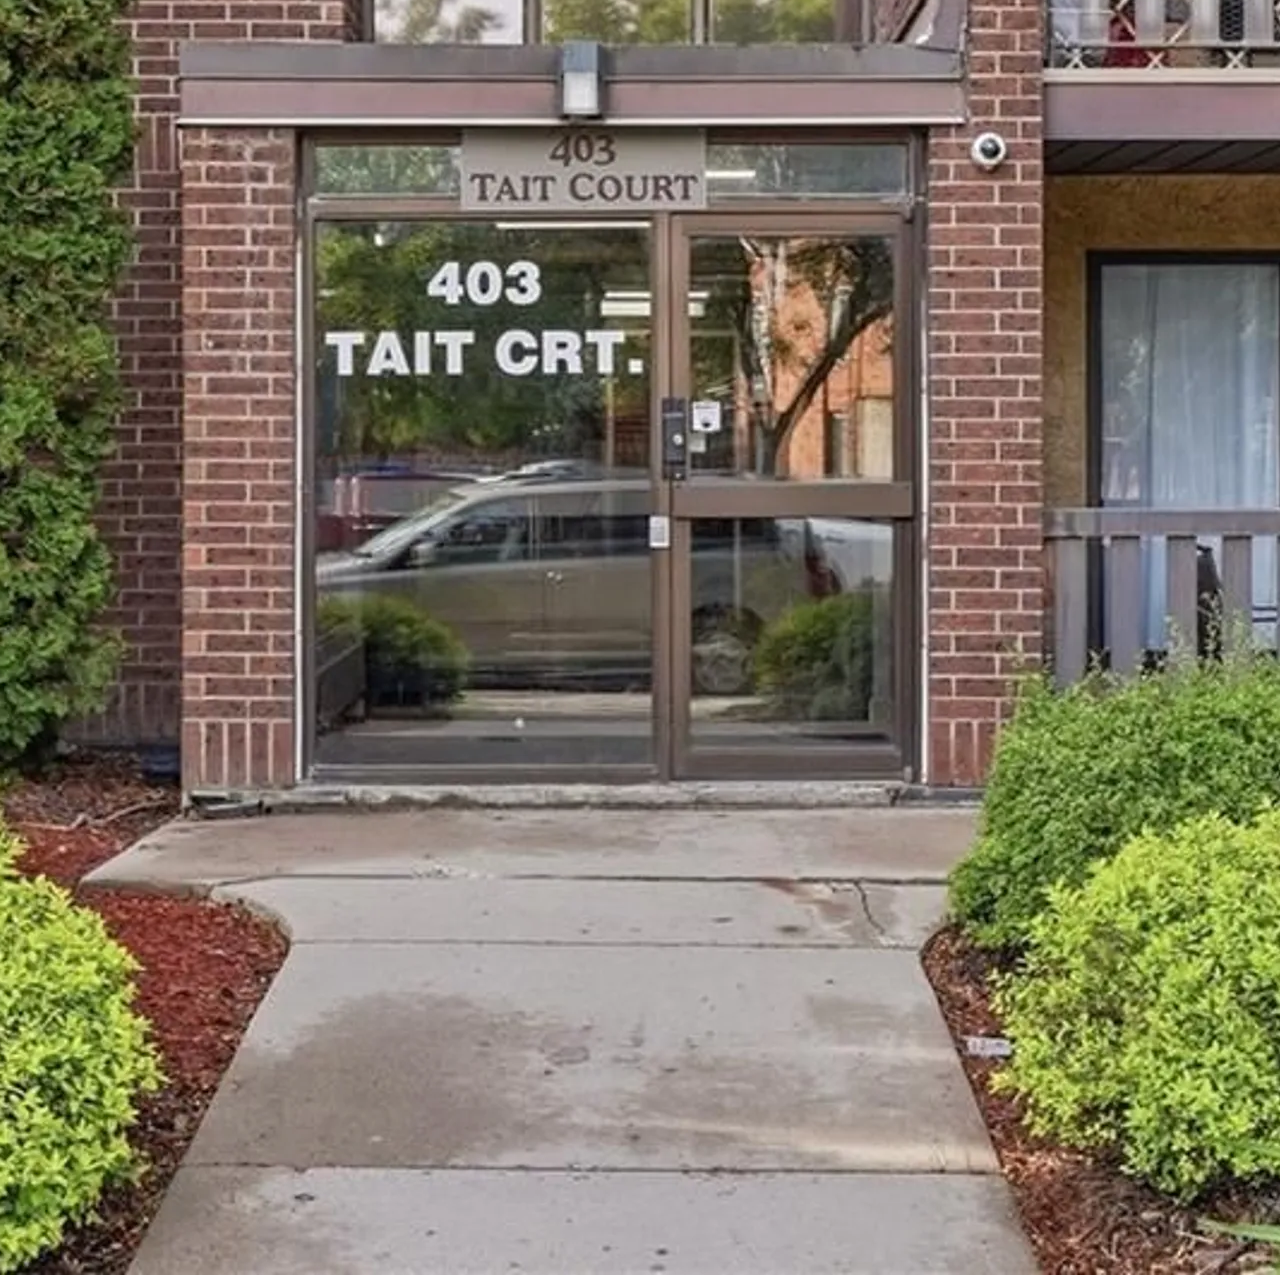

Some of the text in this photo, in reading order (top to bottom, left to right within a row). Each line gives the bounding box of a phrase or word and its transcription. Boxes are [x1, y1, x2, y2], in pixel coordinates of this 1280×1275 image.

[549, 134, 616, 167] 403
[470, 172, 699, 202] TAIT COURT
[426, 260, 543, 306] 403
[324, 329, 645, 376] TAIT CRT.
